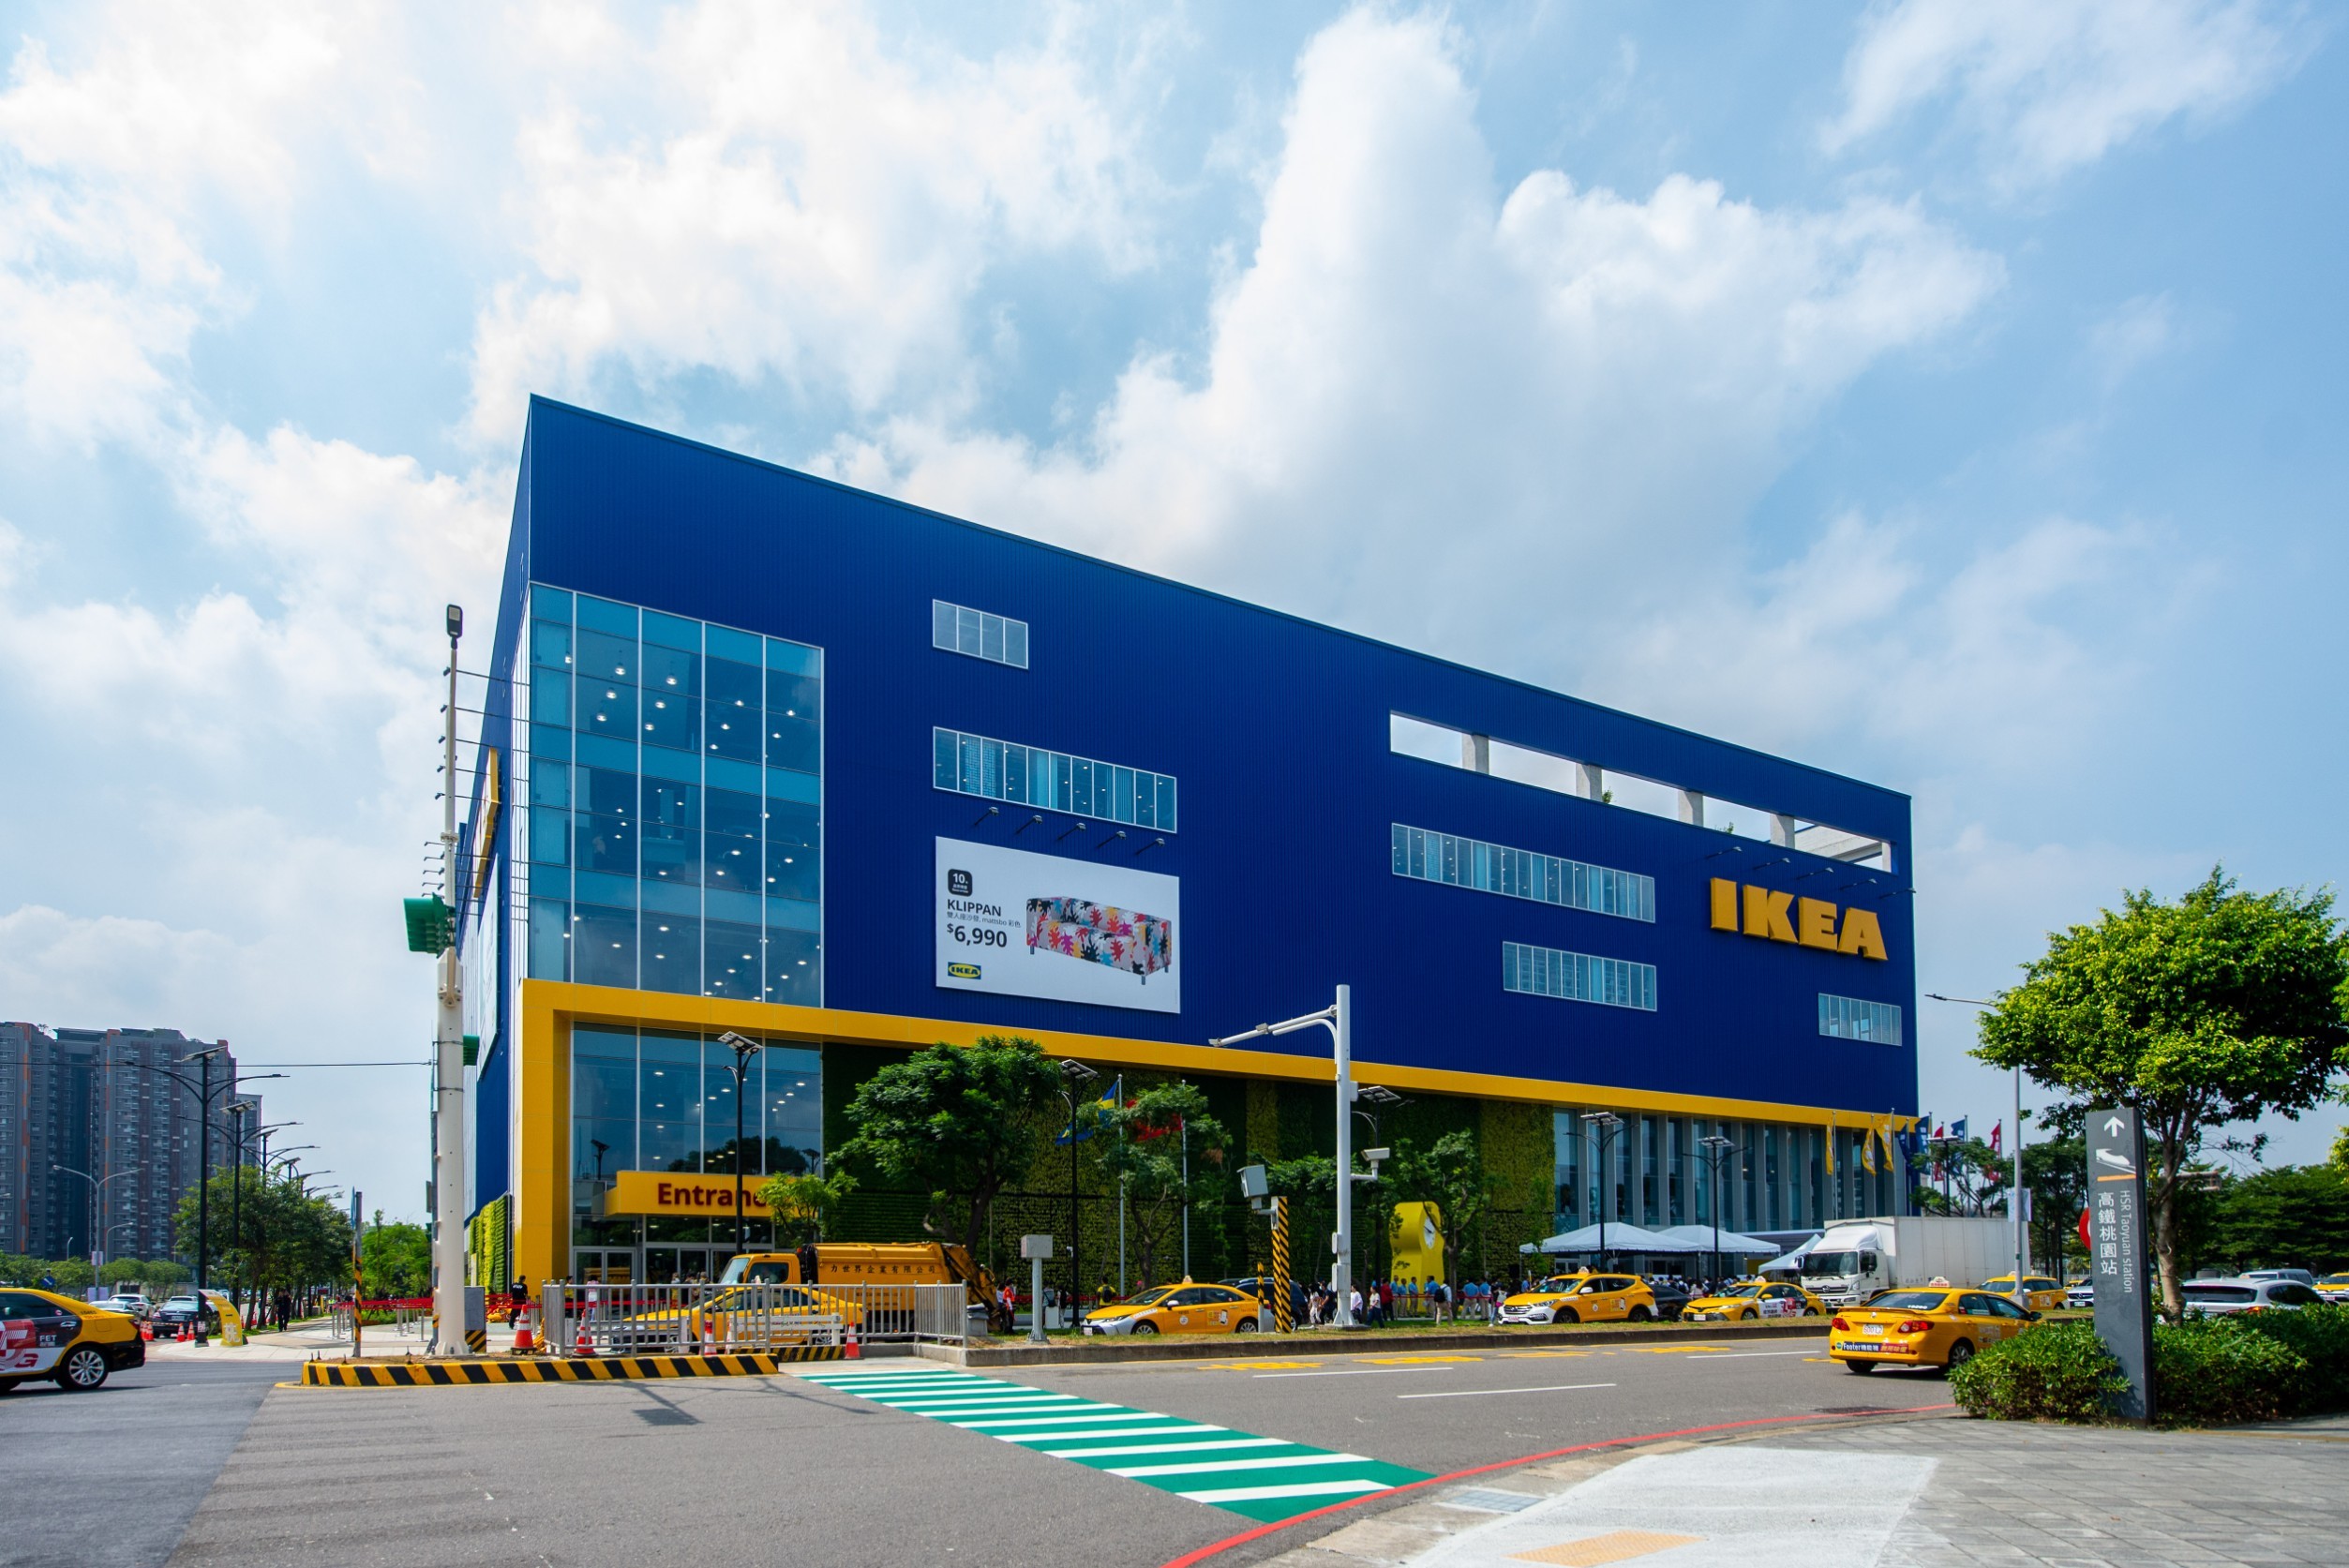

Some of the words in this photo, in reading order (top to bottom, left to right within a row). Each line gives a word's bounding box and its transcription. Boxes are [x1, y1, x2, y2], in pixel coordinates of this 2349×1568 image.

[948, 899, 1001, 917] KLIPPAN
[1711, 877, 1888, 961] IKEA
[981, 917, 1007, 926] mattsbo
[947, 922, 1008, 948] $6,990
[950, 966, 979, 975] IKEA
[2119, 1190, 2132, 1211] HSR
[2098, 1191, 2117, 1276] 高鐵桃園站
[2119, 1214, 2132, 1256] Taoyuan
[2122, 1258, 2135, 1293] station
